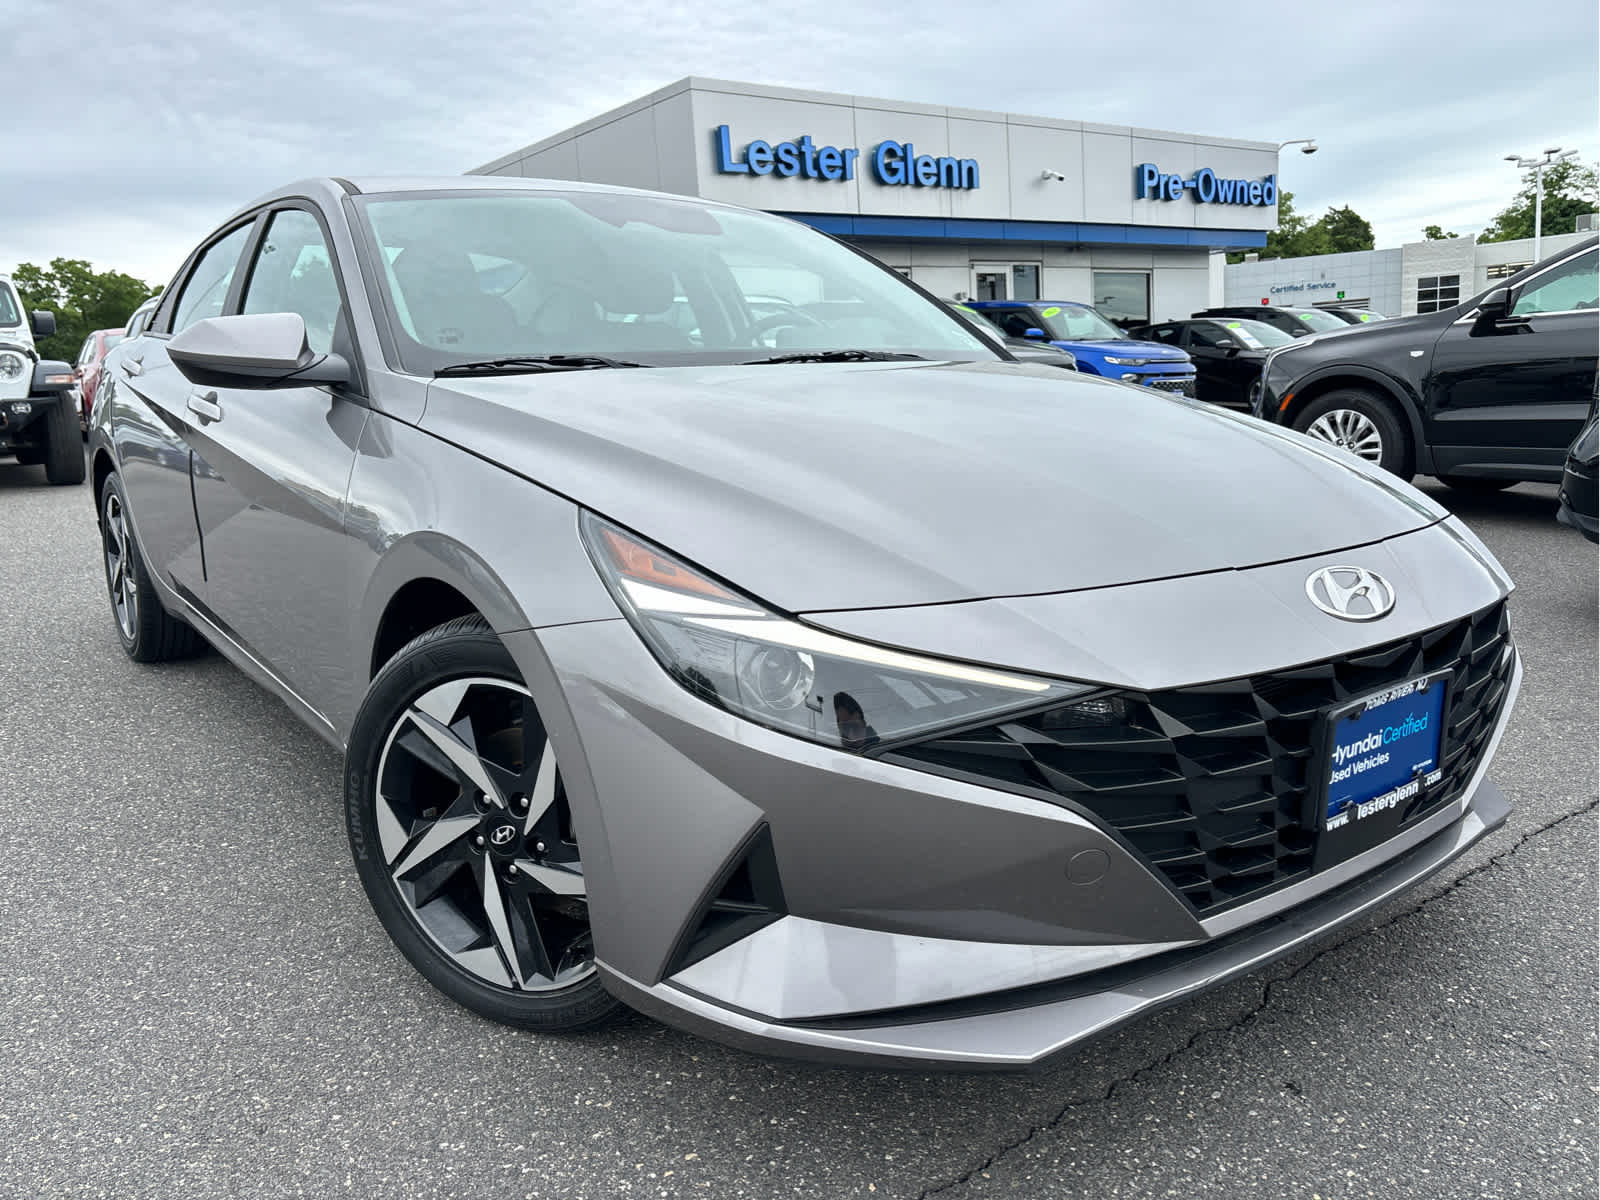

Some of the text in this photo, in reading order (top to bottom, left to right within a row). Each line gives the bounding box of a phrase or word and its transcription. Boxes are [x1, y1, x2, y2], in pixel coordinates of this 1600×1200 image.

[715, 125, 980, 190] Lester Glenn
[1137, 163, 1276, 207] Pre-Owned
[1270, 280, 1337, 294] Certified Service
[1383, 711, 1429, 744] Certified
[1352, 752, 1390, 775] Vehicles
[349, 774, 368, 860] KUMHO
[1356, 782, 1419, 820] lesterglenn
[1424, 771, 1442, 787] .com
